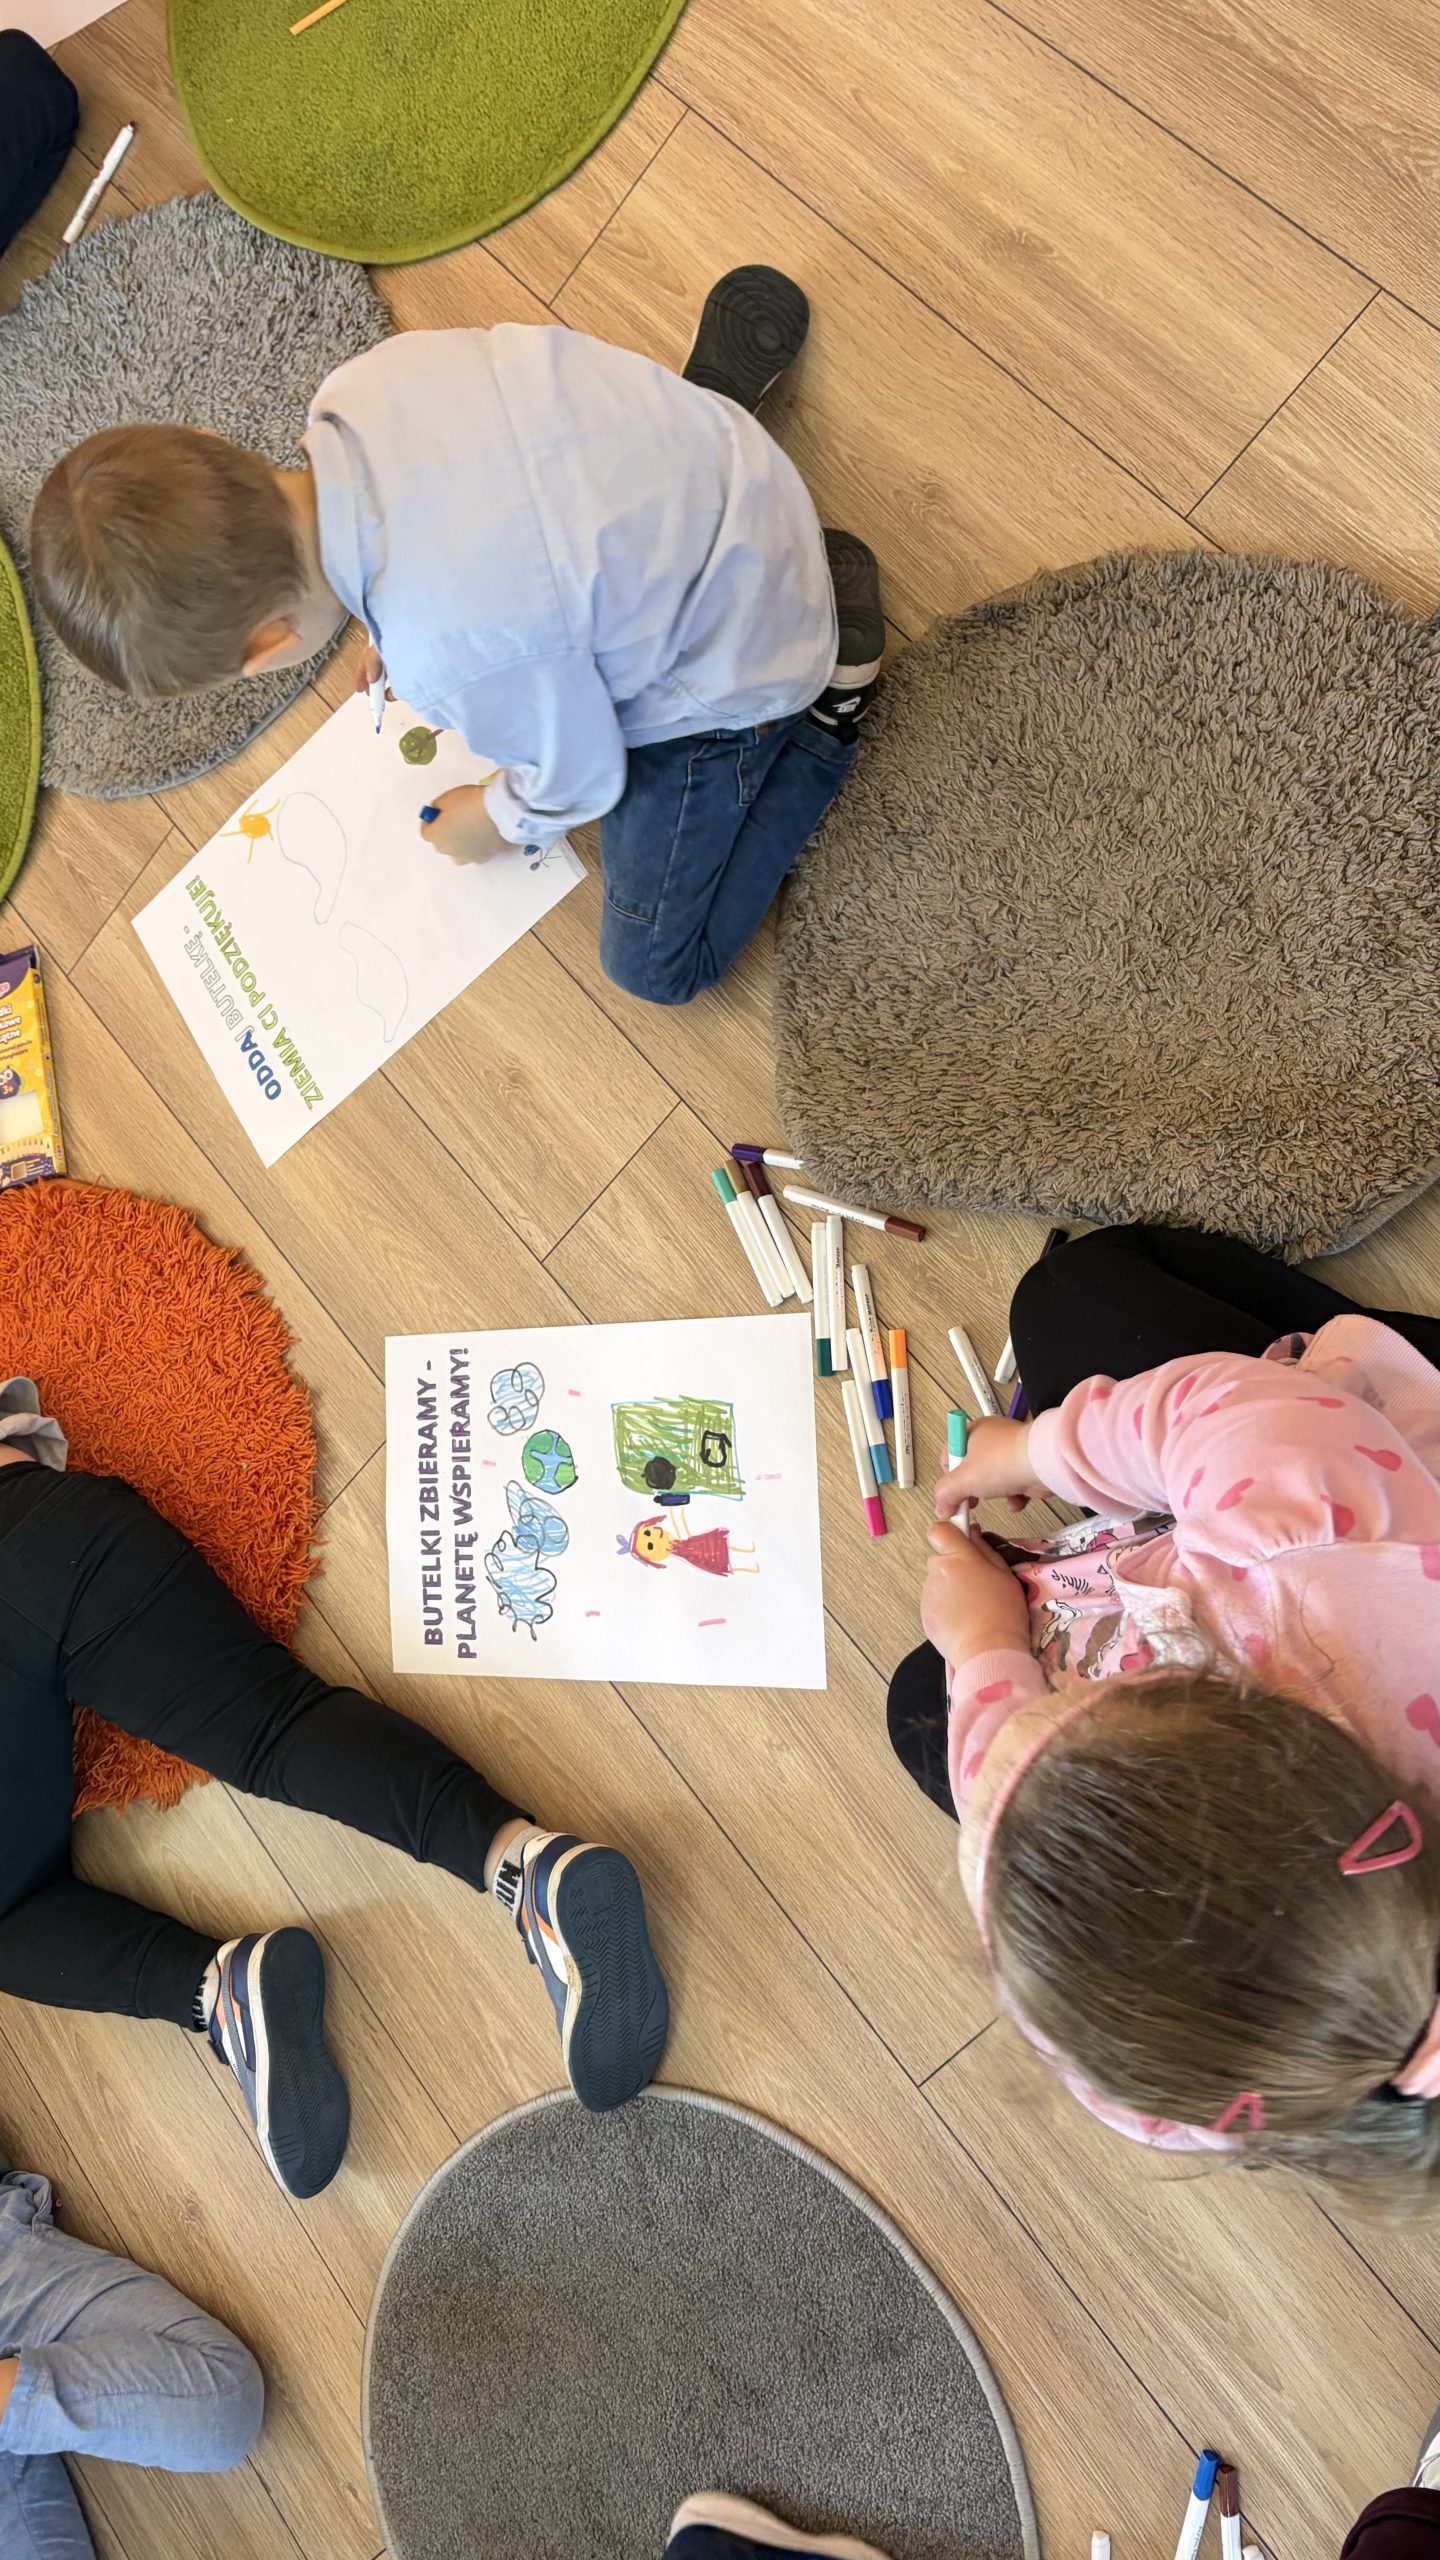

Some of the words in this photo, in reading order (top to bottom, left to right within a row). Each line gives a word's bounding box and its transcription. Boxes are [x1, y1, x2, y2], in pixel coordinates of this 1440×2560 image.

[184, 931, 243, 1030] BUTELKĘ
[186, 875, 266, 1007] PODZIĘKUJE!
[234, 1025, 282, 1100] ODDAJ
[257, 1003, 278, 1030] CI
[272, 1026, 324, 1110] ZIEMIA
[416, 1377, 439, 1522] ZBIERAMY
[449, 1348, 473, 1526] WSPIERAMY!
[420, 1530, 443, 1645] BUTELKI
[453, 1532, 478, 1659] PLANETĘ
